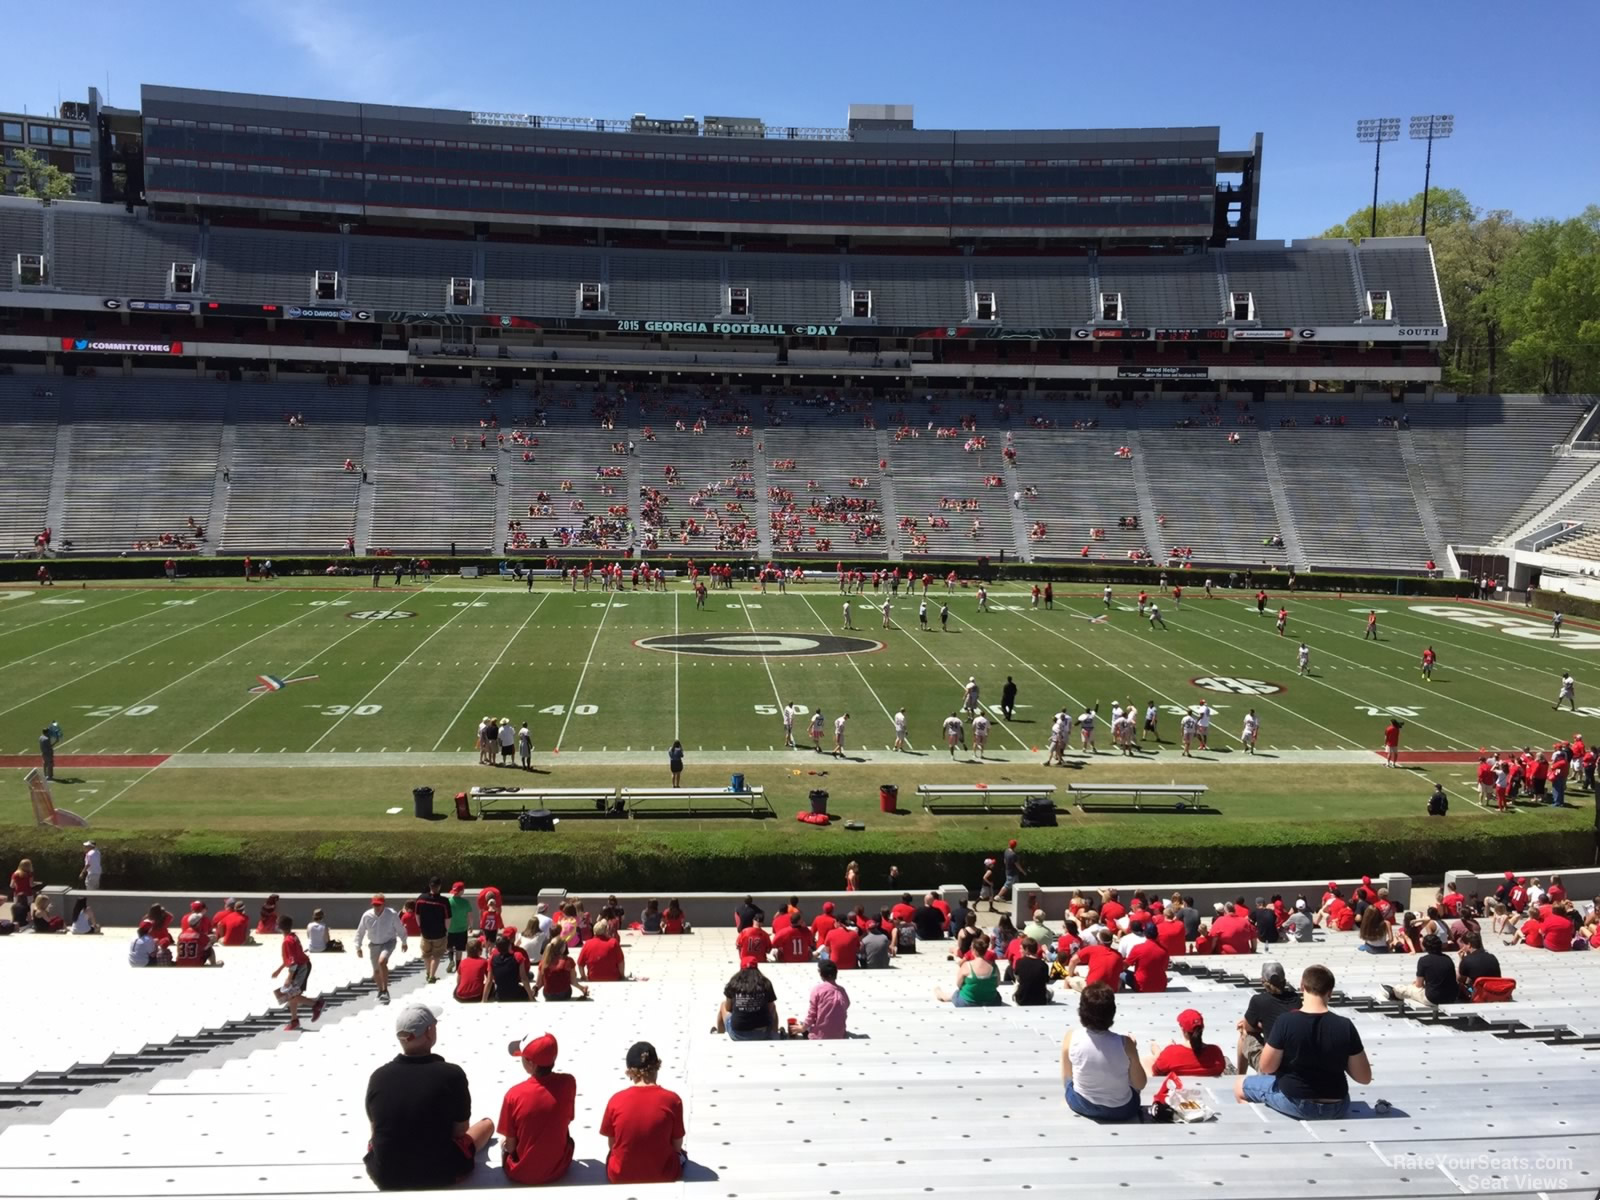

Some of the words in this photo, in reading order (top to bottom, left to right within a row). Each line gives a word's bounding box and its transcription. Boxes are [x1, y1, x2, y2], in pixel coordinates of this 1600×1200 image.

[314, 310, 339, 318] DAWGS!
[618, 320, 639, 331] 2015
[644, 321, 708, 333] GEORGIA
[713, 323, 786, 334] FOOTBALL
[1398, 328, 1440, 336] SOUTH
[88, 342, 170, 352] #COMMITTOTHEG
[83, 705, 159, 717] 20
[320, 704, 383, 716] 30
[538, 704, 599, 716] 40
[754, 704, 810, 716] 50
[1354, 705, 1419, 717] 20
[792, 938, 803, 955] 11
